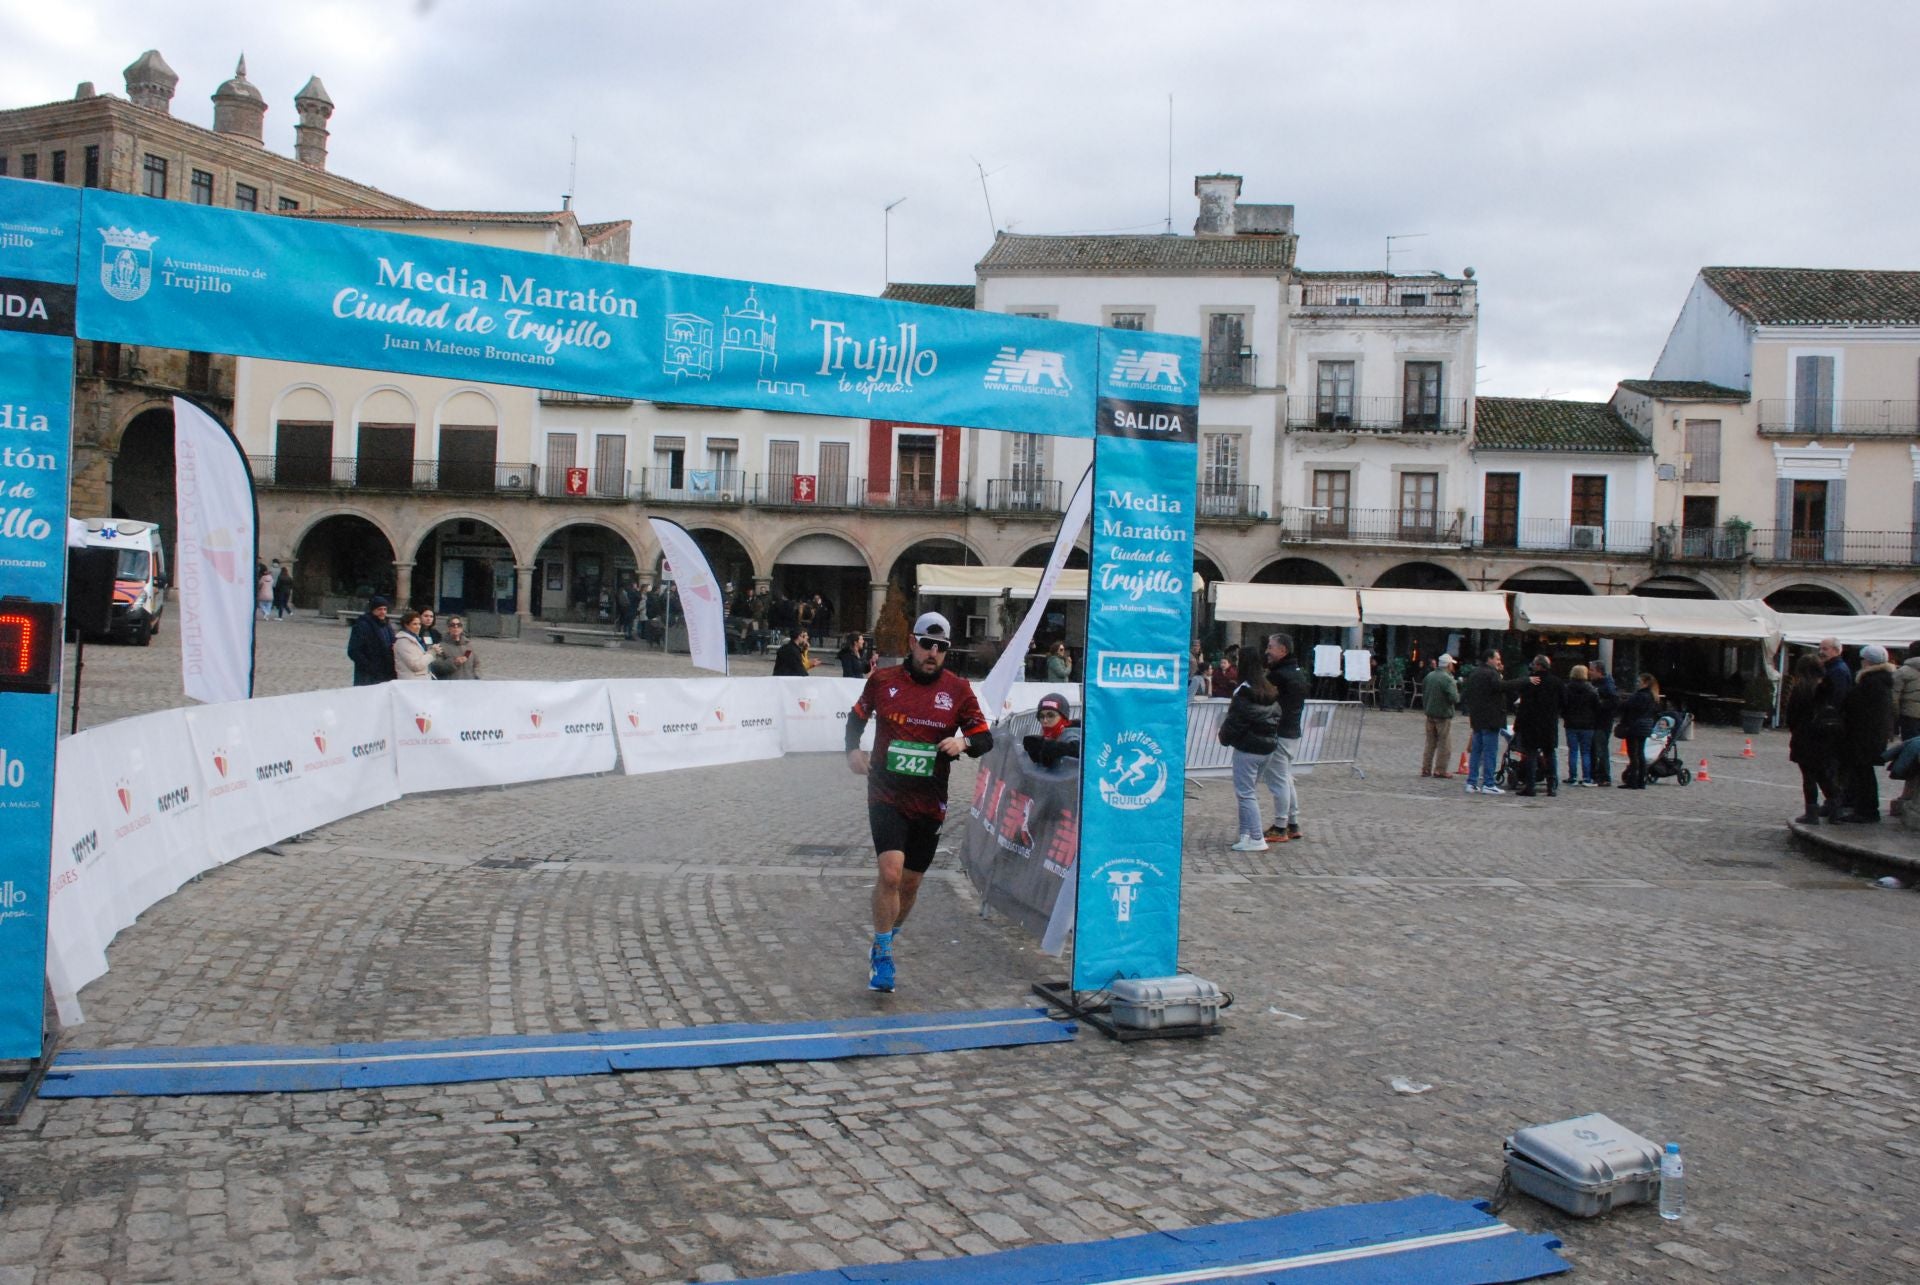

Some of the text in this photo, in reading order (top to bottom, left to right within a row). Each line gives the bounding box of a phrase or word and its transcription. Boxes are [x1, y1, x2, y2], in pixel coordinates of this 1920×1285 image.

[51, 226, 64, 237] de
[162, 257, 267, 280] Ayuntamiento de
[161, 271, 232, 295] Trujillo
[375, 257, 639, 319] Media Maratón
[332, 287, 612, 355] Ciudad de Trujillo
[383, 333, 556, 367] Juan Mateos Broncano
[810, 317, 938, 387] Trujillo
[838, 372, 854, 394] te
[983, 381, 1070, 398] www.musicrun.es
[1108, 379, 1183, 394] www.musicrun.es
[1114, 410, 1183, 433] SALIDA
[8, 481, 36, 499] de
[1107, 490, 1183, 514] Media
[1102, 519, 1187, 543] Maratón
[1110, 545, 1174, 564] Ciudad de
[1099, 563, 1183, 601] Trujillo
[1108, 661, 1168, 680] HABLA
[1096, 729, 1163, 769] Club Atletismo
[895, 754, 928, 774] 242
[1103, 790, 1152, 807] TRUJILLO
[1112, 887, 1137, 901] A J
[1121, 901, 1128, 915] S
